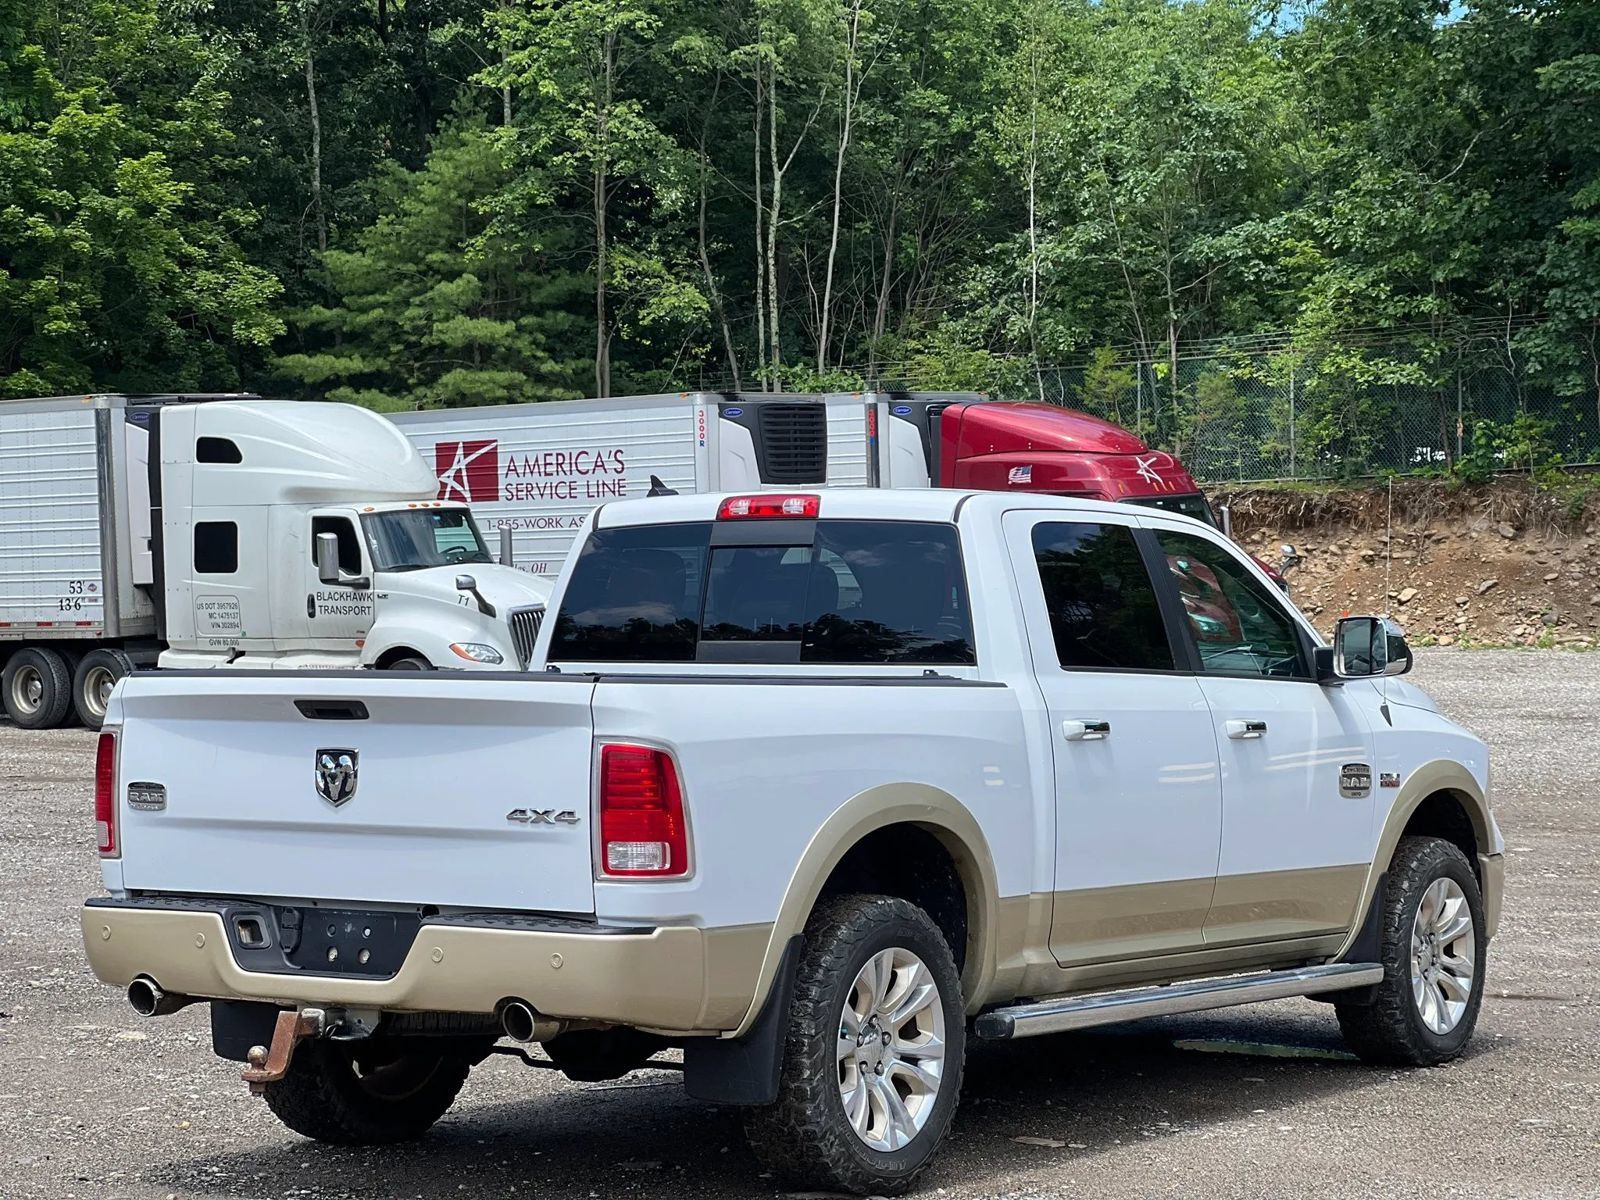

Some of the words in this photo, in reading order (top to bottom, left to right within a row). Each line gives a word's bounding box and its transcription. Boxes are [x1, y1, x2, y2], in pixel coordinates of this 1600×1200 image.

[505, 449, 625, 478] AMERICA'S
[504, 481, 578, 501] SERVICE
[586, 478, 627, 498] LINE
[531, 563, 547, 574] OH
[316, 591, 373, 602] BLACKHAWK
[196, 602, 204, 610] US
[205, 602, 216, 610] DOT
[318, 605, 372, 616] TRANSPORT
[208, 612, 217, 620] MC
[1342, 776, 1370, 788] RAM
[129, 791, 164, 802] RAM
